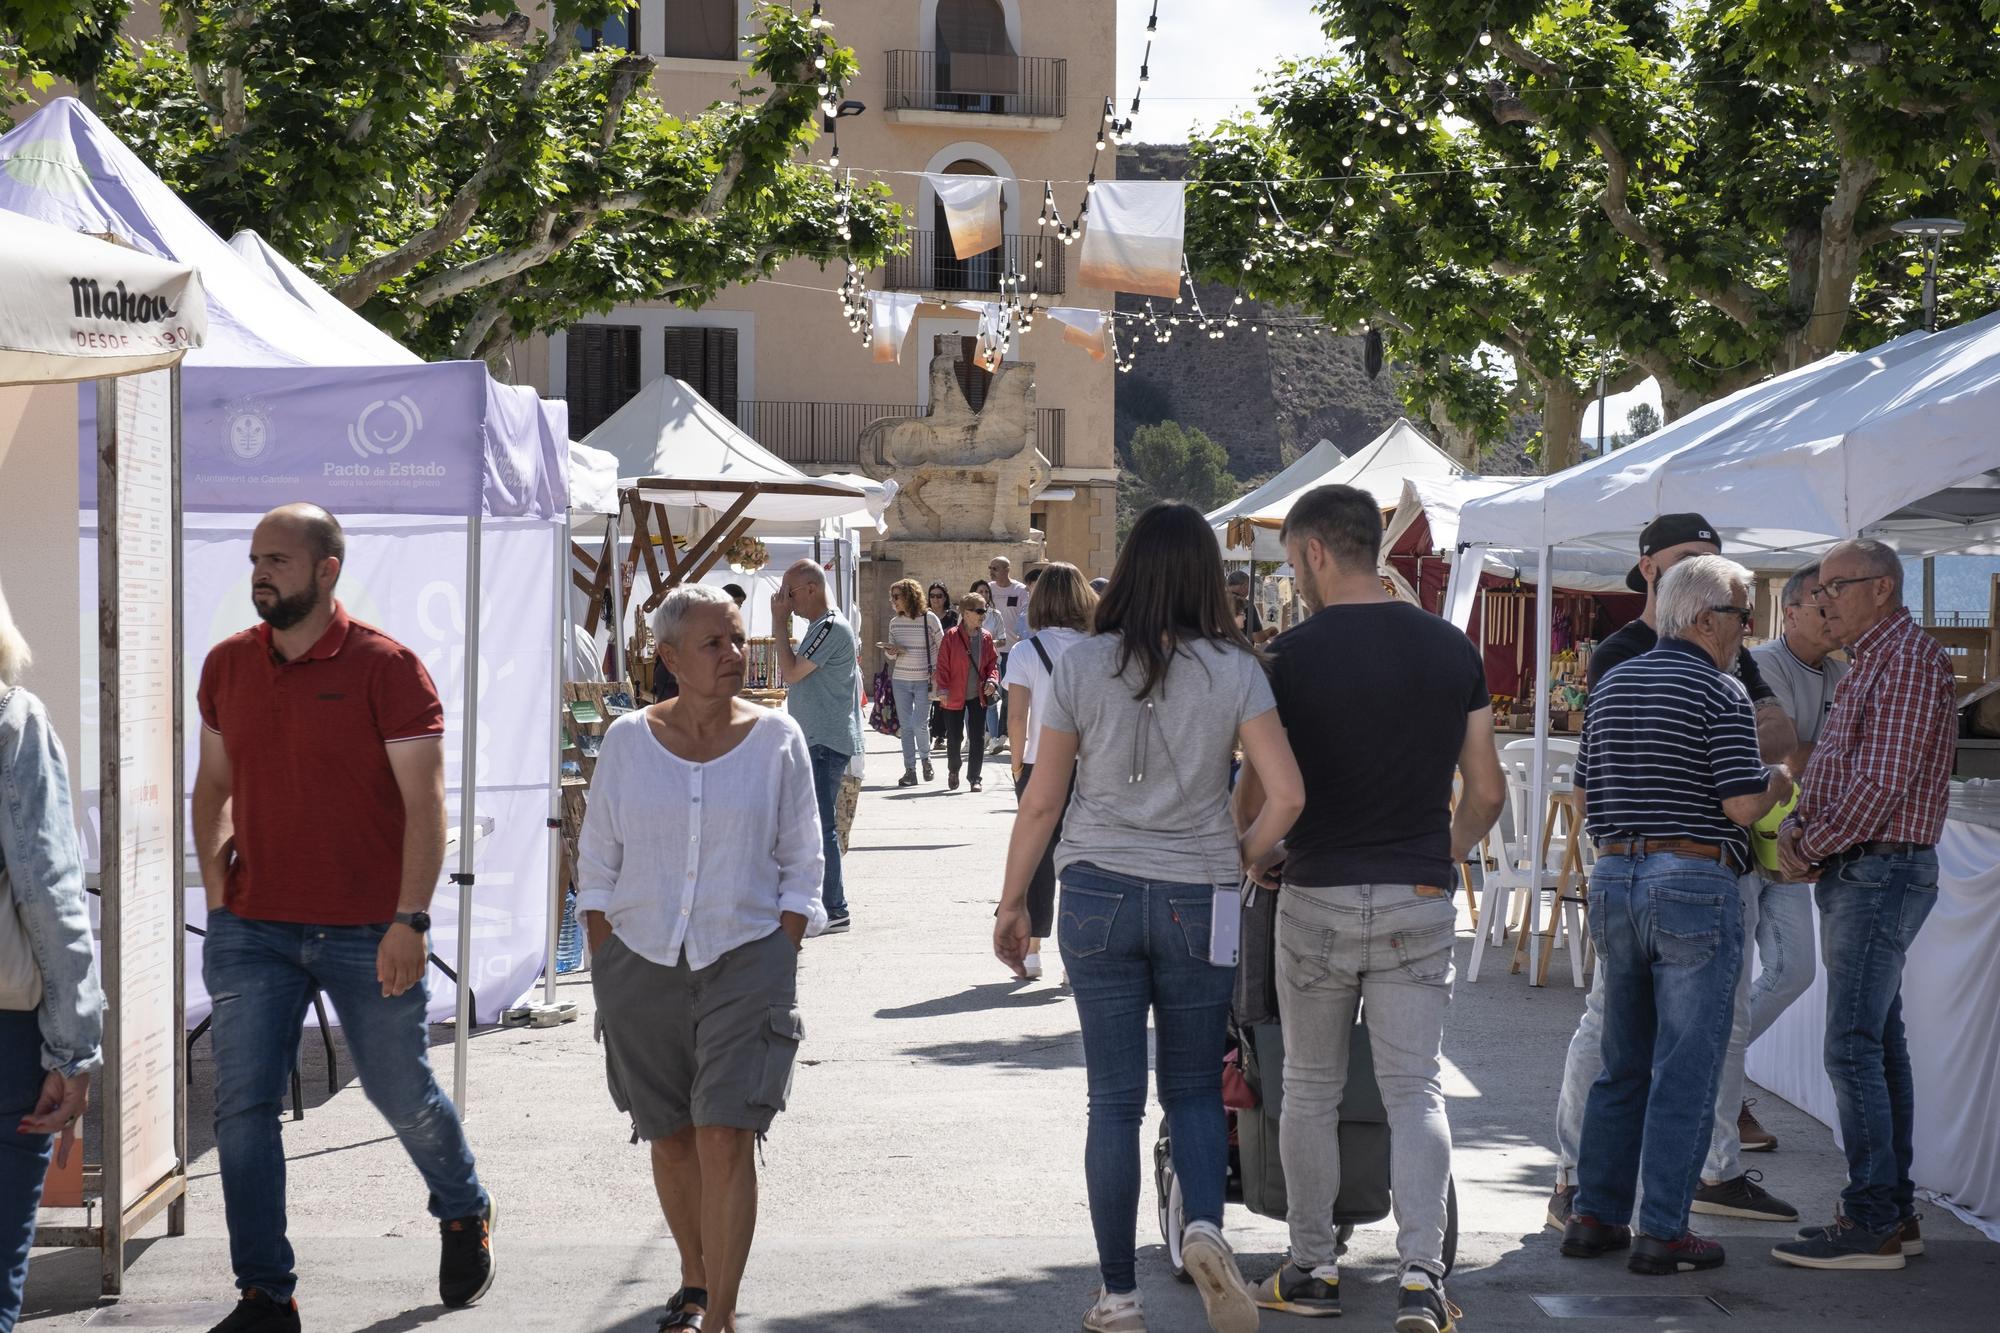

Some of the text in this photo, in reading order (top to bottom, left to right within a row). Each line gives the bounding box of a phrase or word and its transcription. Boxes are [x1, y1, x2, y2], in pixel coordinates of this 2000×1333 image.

[69, 276, 178, 323] Mahou
[322, 461, 447, 477] Pacto de Estado
